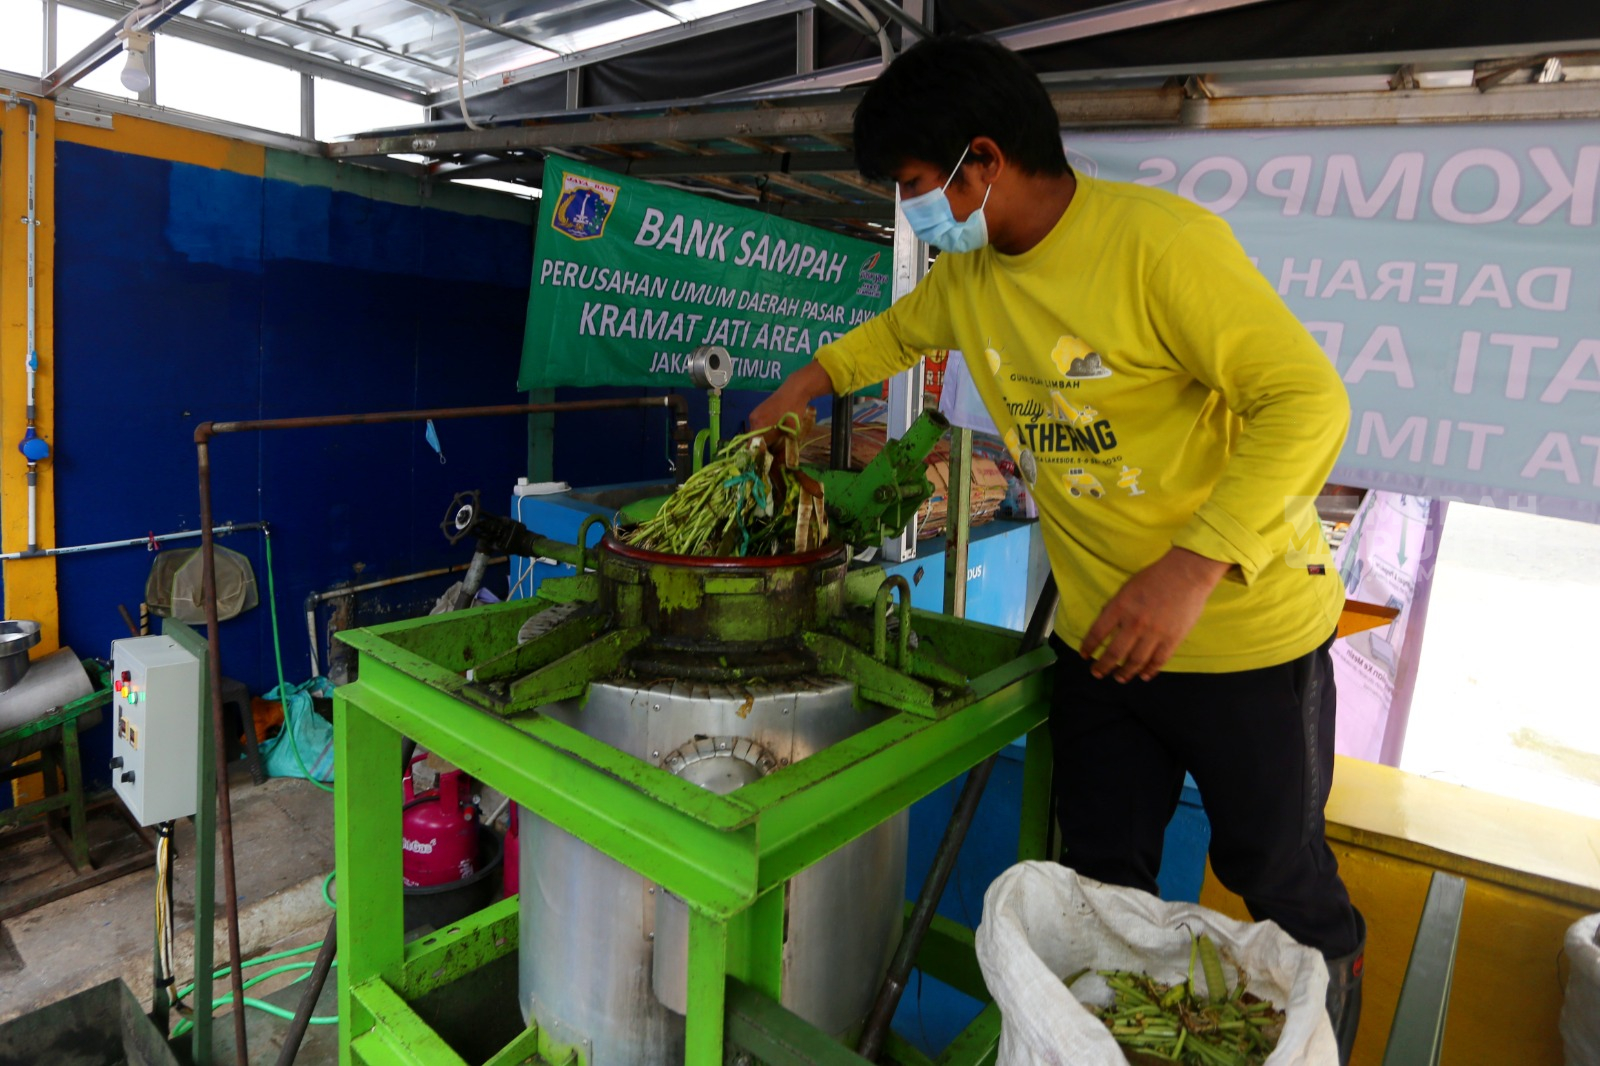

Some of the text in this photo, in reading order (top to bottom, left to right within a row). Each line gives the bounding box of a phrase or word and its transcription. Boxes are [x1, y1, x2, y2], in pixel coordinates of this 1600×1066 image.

[566, 176, 589, 187] JAYA
[634, 207, 848, 283] BANK SAMPAH
[540, 259, 669, 299] PERUSAHAN
[670, 279, 737, 309] UMUM
[737, 289, 800, 317] DAERAH
[800, 300, 845, 324] PASAR
[579, 301, 703, 343] KRAMAT
[701, 316, 751, 348] JATI
[751, 322, 811, 355] AREA
[649, 351, 782, 380] JAKA TIMUR
[1044, 379, 1081, 389] LIMBAH
